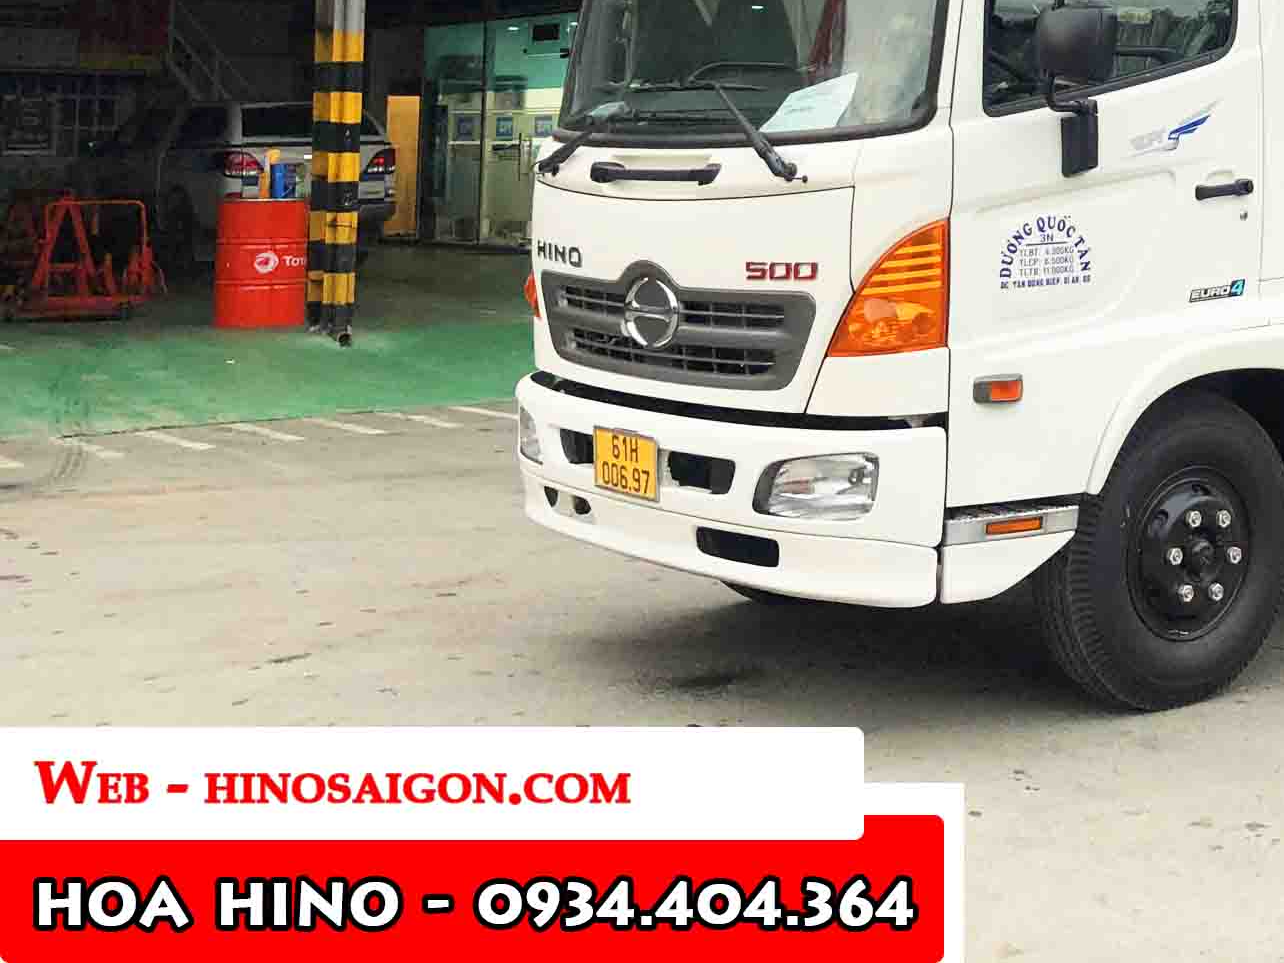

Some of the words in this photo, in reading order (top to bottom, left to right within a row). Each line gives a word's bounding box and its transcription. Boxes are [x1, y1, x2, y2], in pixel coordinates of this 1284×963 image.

[537, 240, 583, 268] HINO
[745, 261, 819, 281] 500
[612, 434, 639, 463] 61H
[602, 461, 650, 494] 006.97
